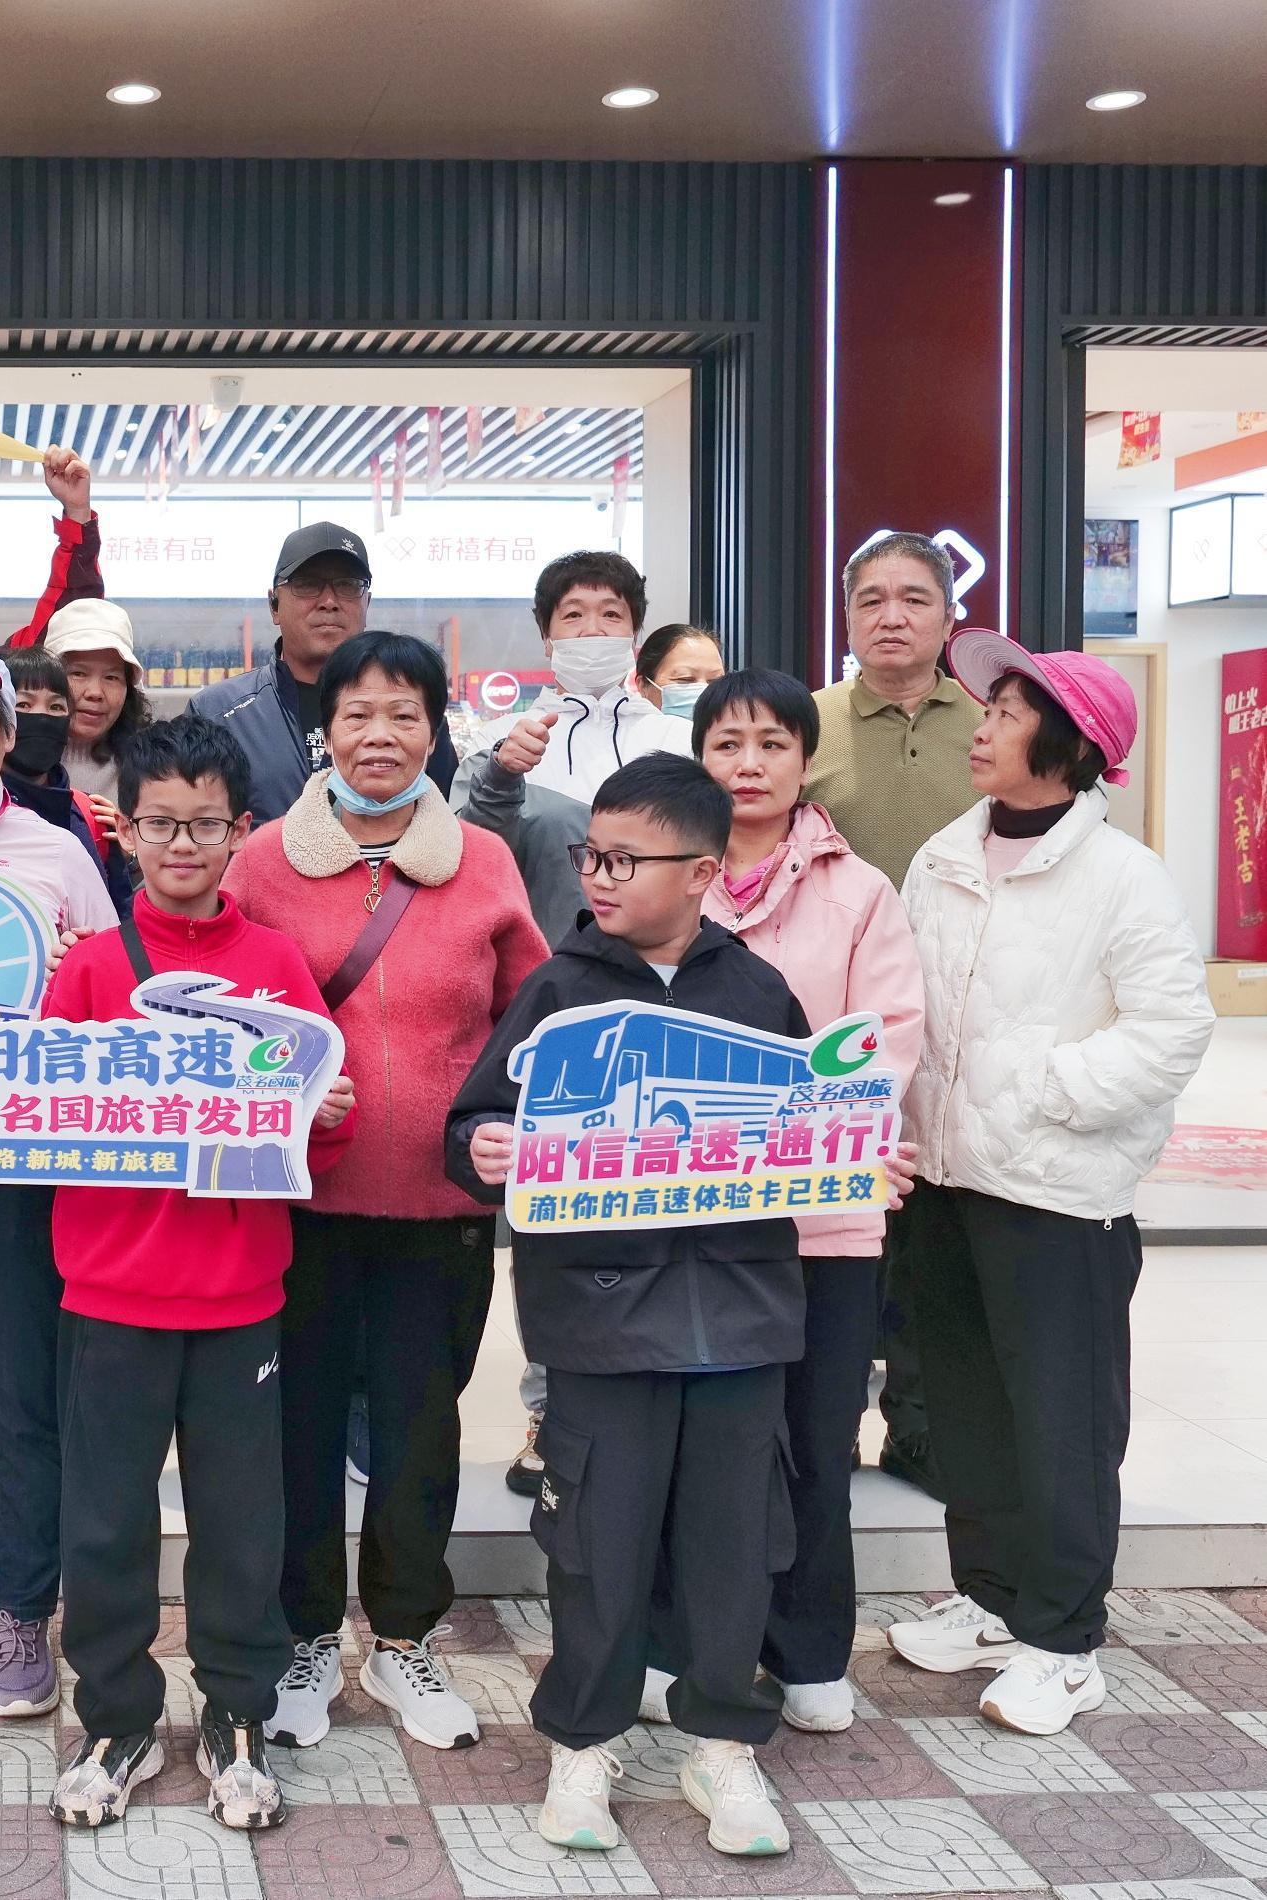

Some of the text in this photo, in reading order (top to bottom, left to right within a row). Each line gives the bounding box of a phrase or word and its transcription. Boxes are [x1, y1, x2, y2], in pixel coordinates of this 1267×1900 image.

[105, 537, 214, 561] 新禧有品
[428, 537, 535, 561] 新禧有品
[1233, 796, 1255, 884] 王老吉
[797, 1101, 885, 1114] MITS
[527, 1172, 876, 1223] 滴!你的高速体验卡已生效
